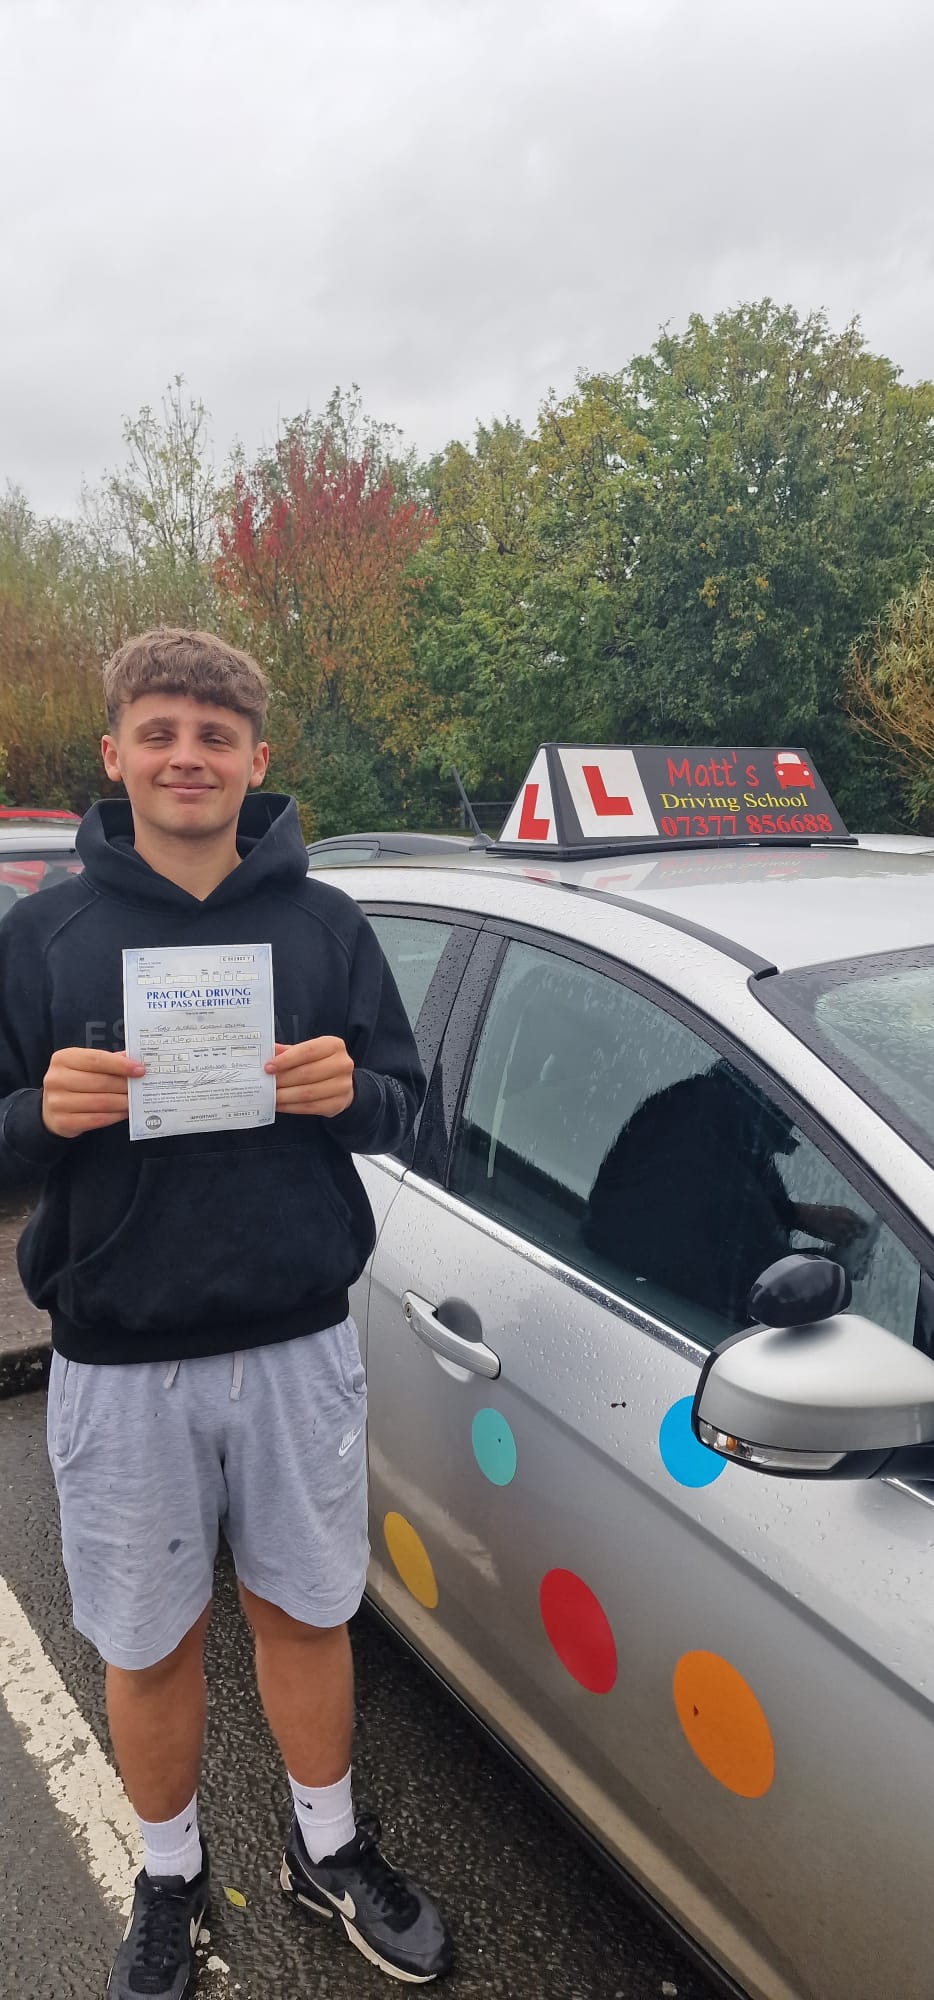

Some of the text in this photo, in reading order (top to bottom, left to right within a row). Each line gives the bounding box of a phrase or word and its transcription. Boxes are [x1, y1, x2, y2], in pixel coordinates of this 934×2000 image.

[666, 752, 759, 789] Matt's
[582, 766, 634, 816] L
[660, 792, 808, 811] Driving School
[518, 784, 550, 840] L
[660, 814, 832, 837] 07377 856688
[146, 987, 251, 1000] PRACTICAL DRIVING
[147, 997, 251, 1009] TEST PASS CERTIFICATE
